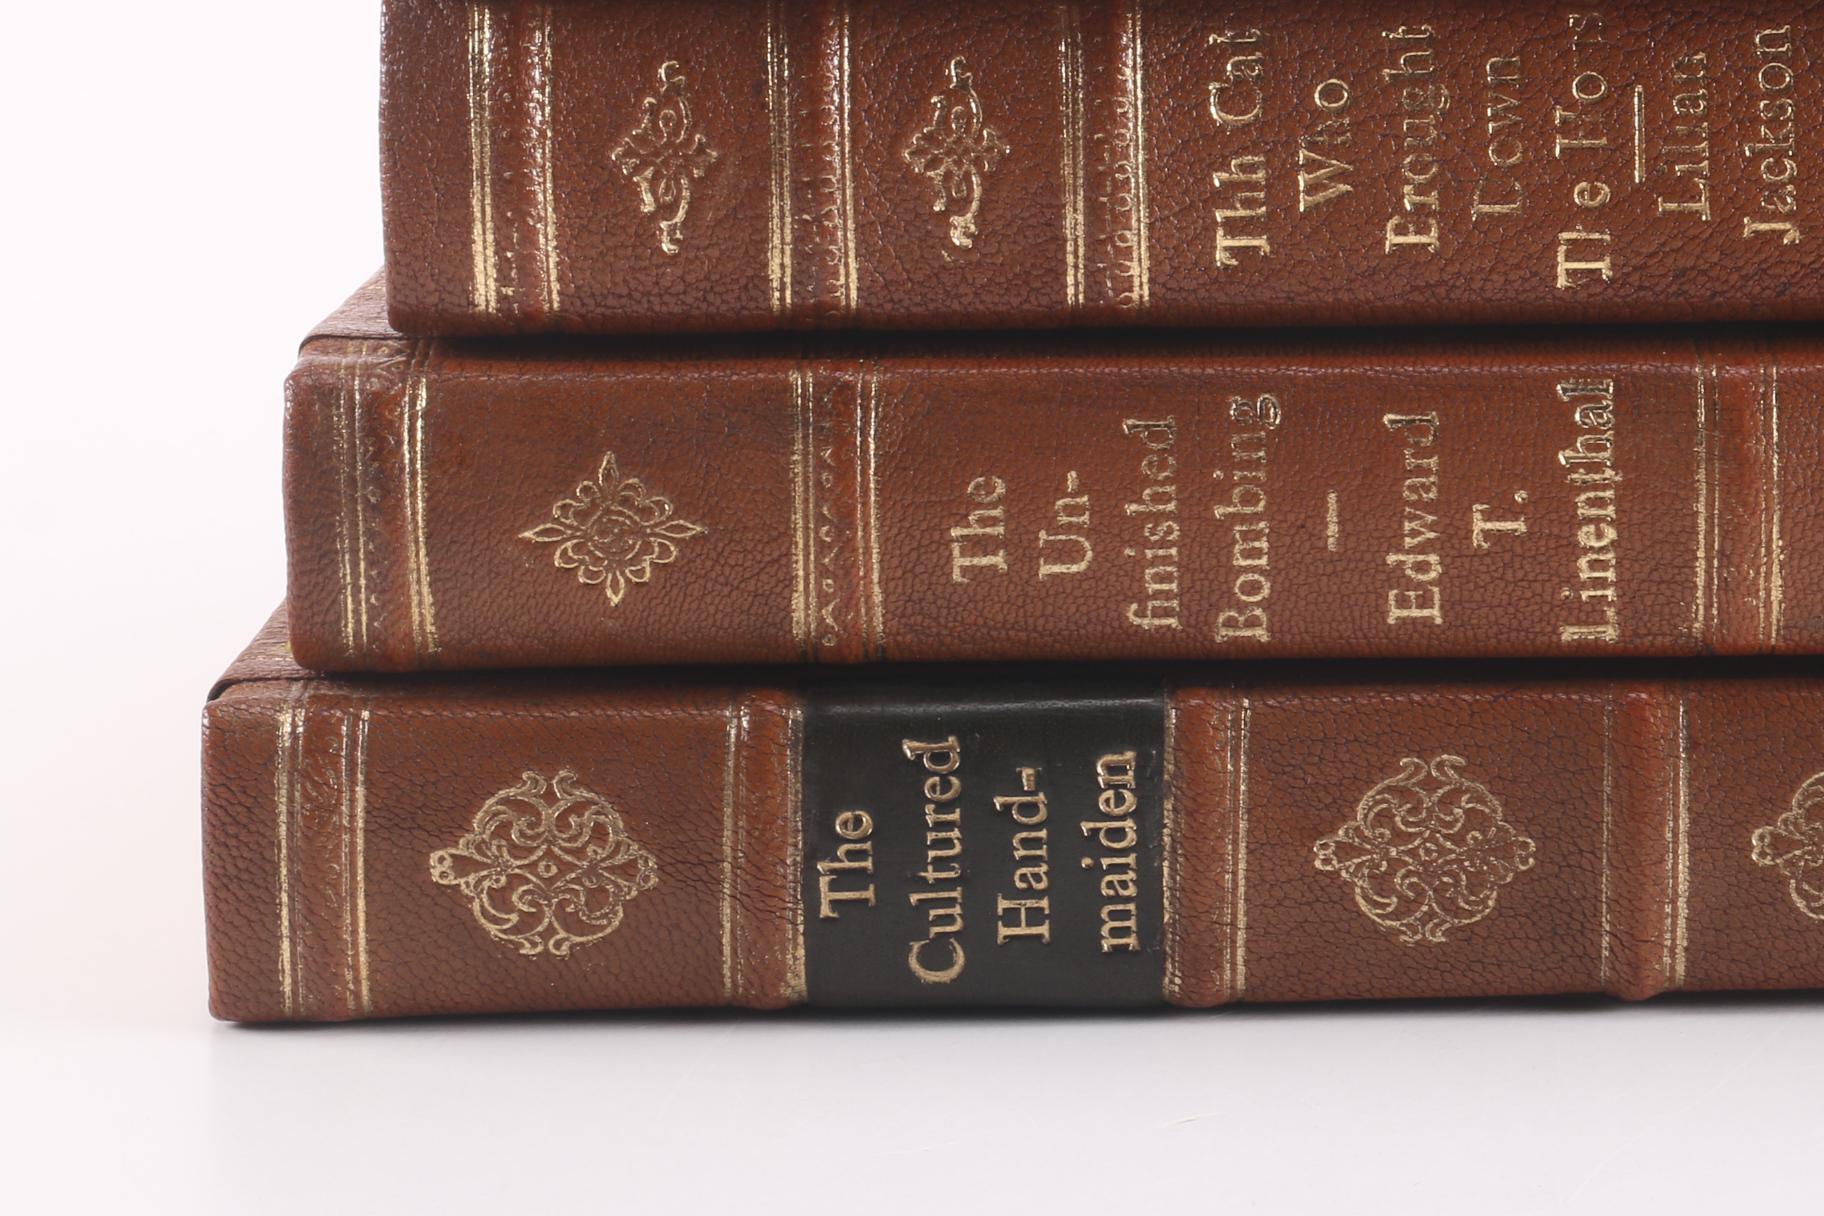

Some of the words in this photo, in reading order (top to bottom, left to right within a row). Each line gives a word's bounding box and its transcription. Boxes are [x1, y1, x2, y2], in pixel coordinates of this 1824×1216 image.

[1208, 28, 1266, 126] Cat
[1298, 78, 1354, 212] Who
[1657, 51, 1711, 222] Lilian
[1743, 25, 1801, 246] Jackson
[950, 475, 1008, 584] The
[1038, 470, 1094, 581] Un-
[1122, 415, 1183, 630] finished
[1213, 393, 1282, 643] Bombing
[1383, 411, 1443, 625] Edward
[1472, 490, 1529, 550] T.
[1556, 378, 1623, 643] Linenthal
[816, 809, 876, 919] The
[902, 735, 967, 984] Cultured
[993, 766, 1051, 945] Hand-
[1080, 749, 1141, 953] maiden
